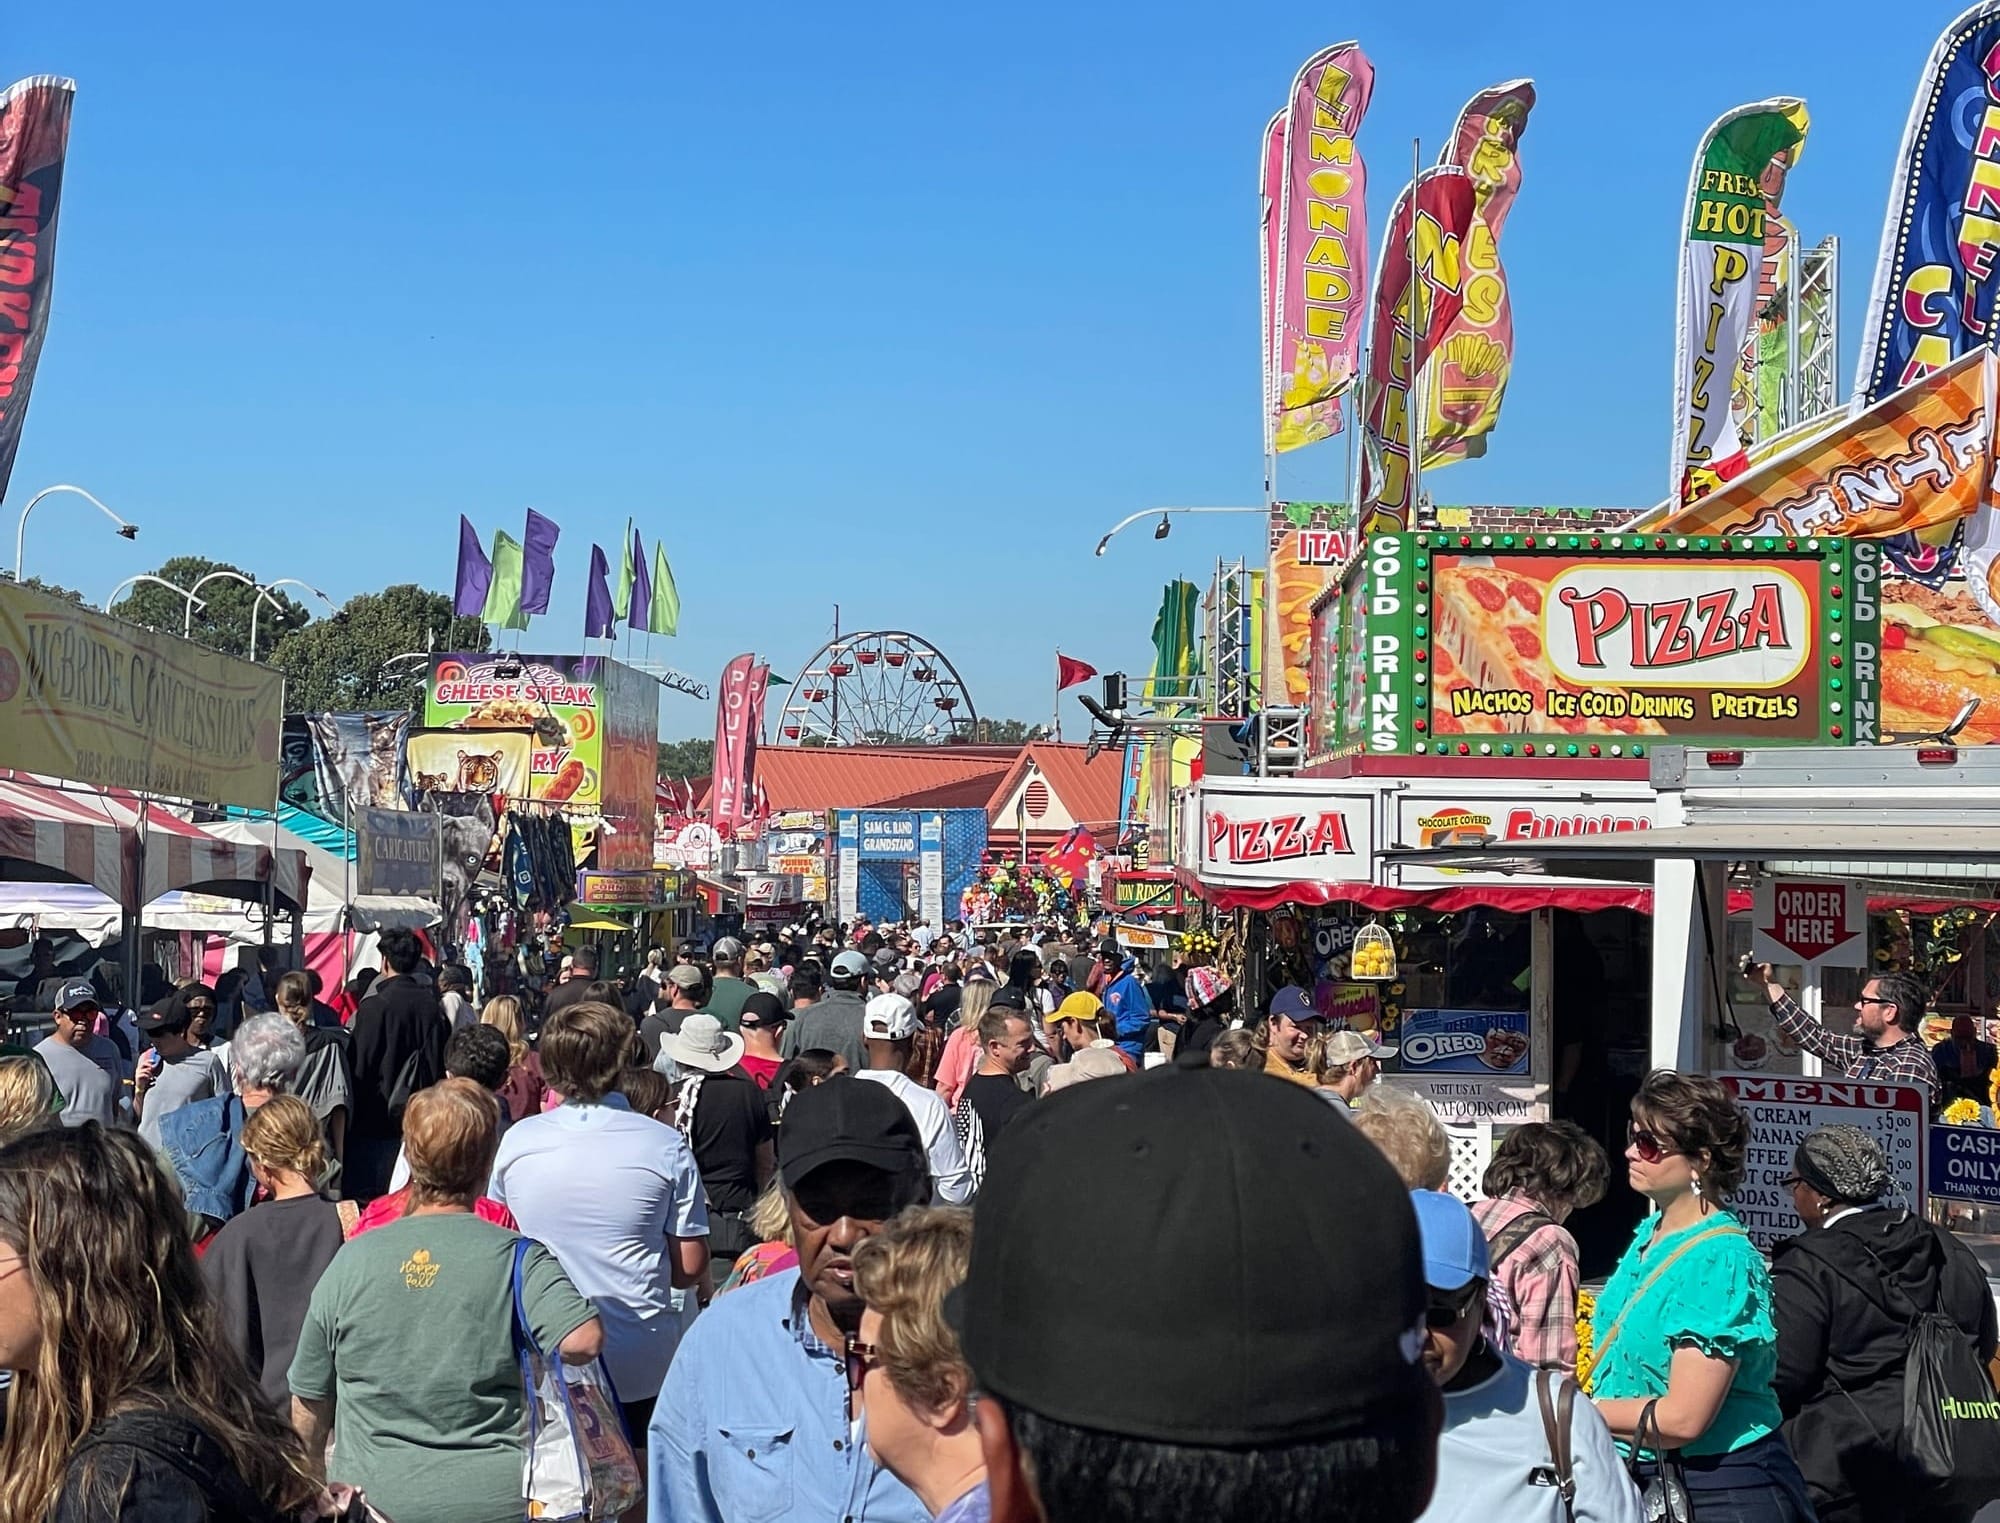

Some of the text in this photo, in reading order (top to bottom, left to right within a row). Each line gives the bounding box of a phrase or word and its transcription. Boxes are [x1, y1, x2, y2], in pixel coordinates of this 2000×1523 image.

[1306, 63, 1353, 340] LEMONADE
[1700, 200, 1766, 238] HOT
[1685, 246, 1747, 503] PIZZA
[1373, 536, 1400, 615] COLD
[1855, 543, 1875, 622] COLD
[1560, 584, 1791, 668] PIZZA
[130, 653, 257, 757] CONCESSIONS
[437, 683, 594, 706] CHEESE STEAK
[1373, 635, 1400, 752] DRINKS
[1452, 689, 1798, 718] NACHOS ICE COLD DRINKS PRETZELS
[863, 821, 883, 835] SAM
[1418, 816, 1491, 827] CHOCOLATE COVERED
[375, 836, 430, 862] CARICATURES
[863, 838, 914, 851] GRANDSTAND
[1205, 811, 1352, 863] PIZZA
[1136, 882, 1172, 901] RINGS
[1778, 891, 1842, 918] ORDER
[1785, 920, 1834, 945] HERE
[1431, 1084, 1483, 1095] VISIT US AT
[1736, 1079, 1898, 1108] MENU
[1754, 1108, 1911, 1132] CREAM $5.00
[1747, 1149, 1788, 1165] FFEE
[1946, 1133, 2000, 1156] CASH
[1947, 1158, 2000, 1181] ONLY
[1724, 1190, 1779, 1207] SODAS
[1944, 1181, 1981, 1194] THANK
[1737, 1210, 1800, 1229] OTTLED
